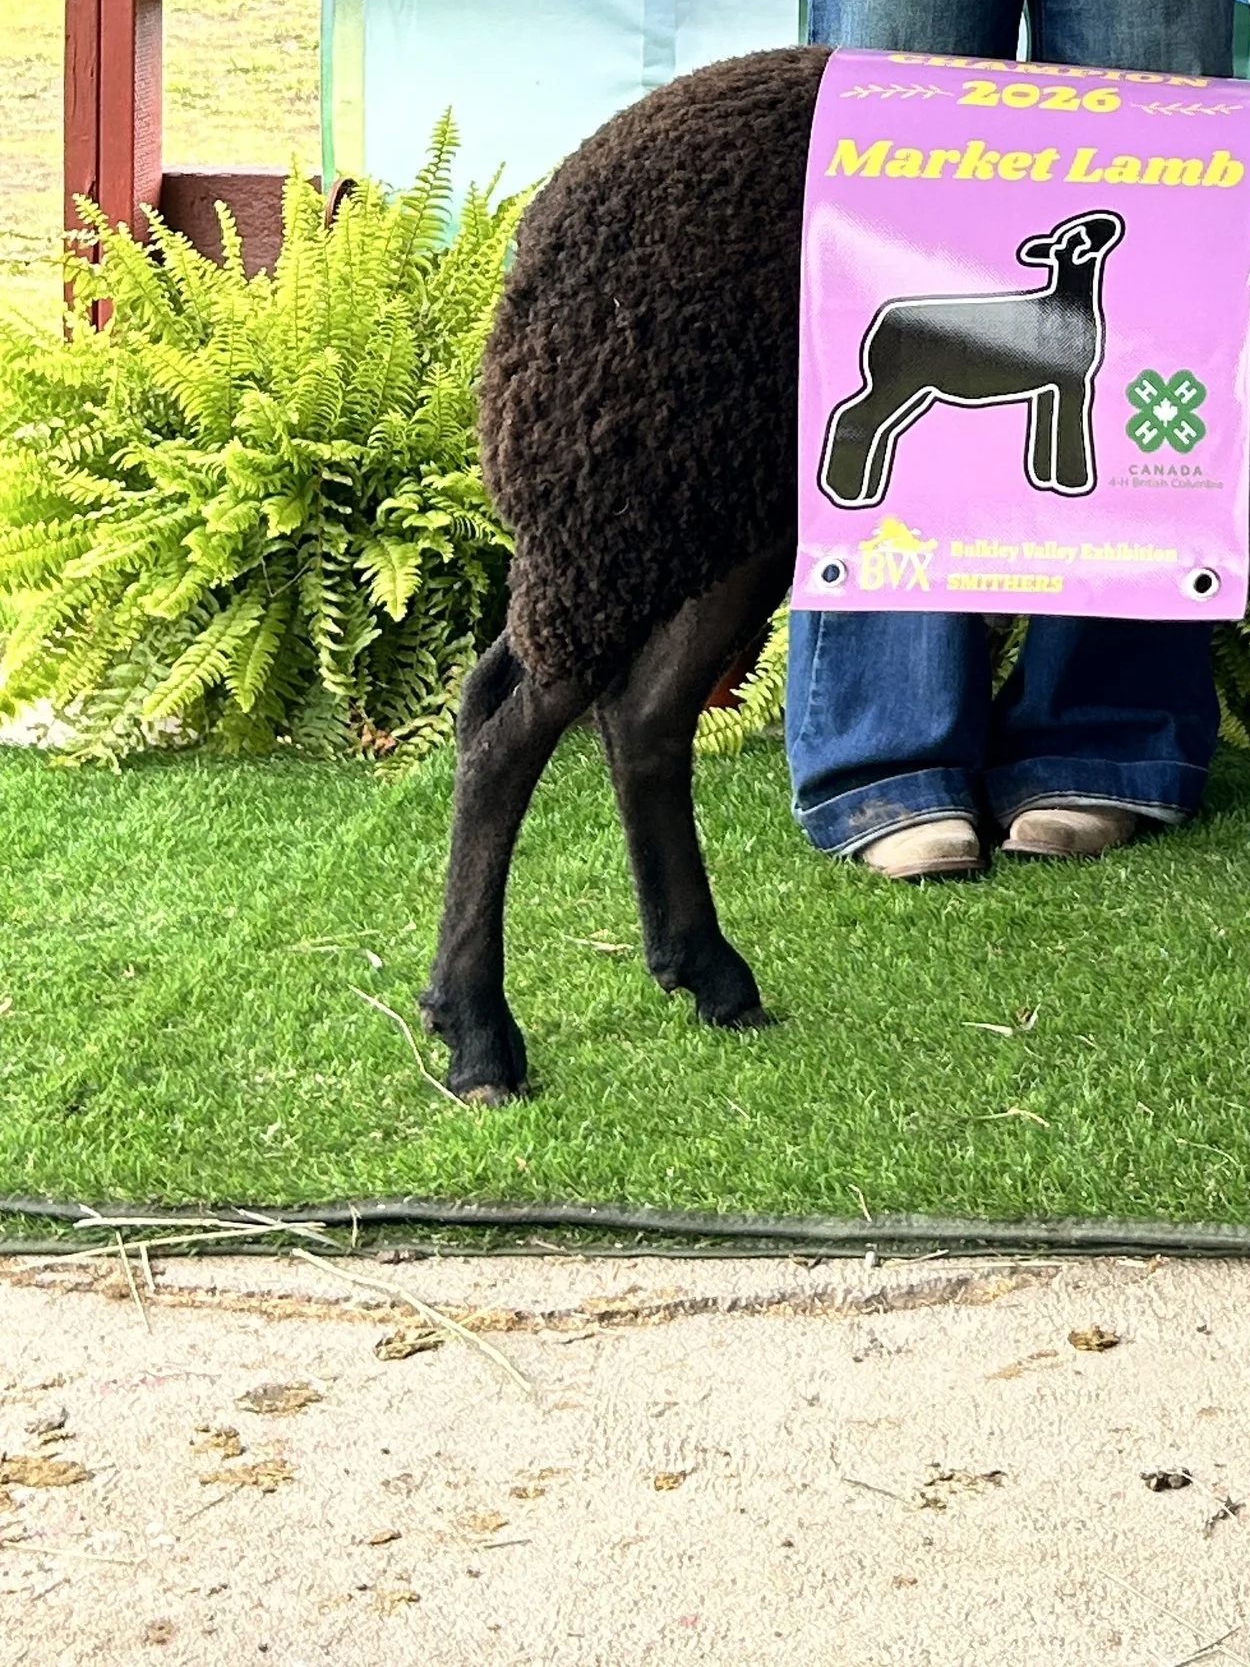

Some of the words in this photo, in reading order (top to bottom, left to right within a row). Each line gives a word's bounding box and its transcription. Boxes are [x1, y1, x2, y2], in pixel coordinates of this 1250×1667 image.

[957, 80, 1121, 113] 2026
[824, 139, 1061, 182] Market
[1063, 147, 1244, 188] Lamb
[1128, 464, 1203, 476] CANADA
[1132, 477, 1168, 488] British
[1171, 479, 1223, 489] Columbia
[950, 540, 1019, 562] Bulkley
[1022, 541, 1077, 564] Valley
[1080, 543, 1178, 563] Exhibition
[859, 548, 932, 592] BVX
[946, 573, 1063, 593] SMITHERS
